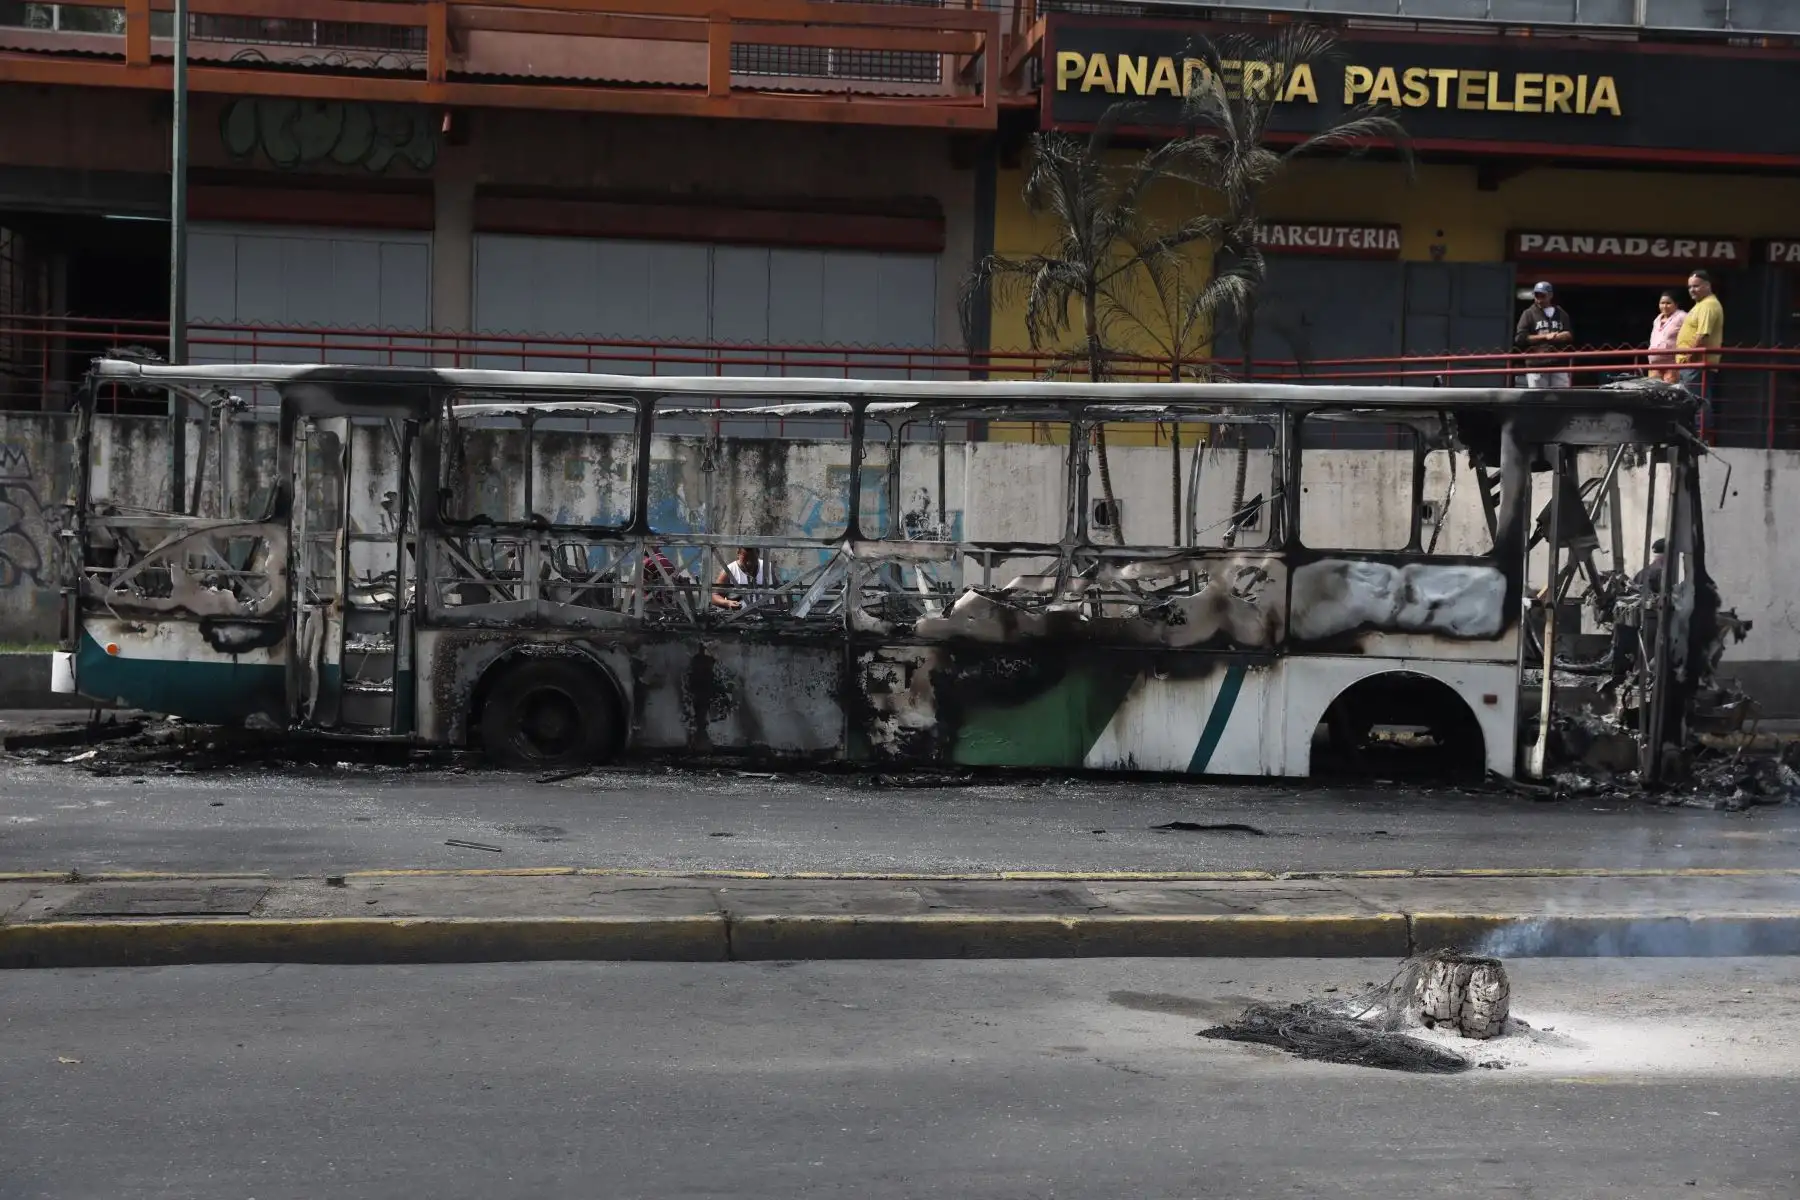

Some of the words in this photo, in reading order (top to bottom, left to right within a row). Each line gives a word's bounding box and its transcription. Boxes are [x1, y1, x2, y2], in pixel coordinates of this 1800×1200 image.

[1056, 51, 1319, 104] PANADERIA
[1343, 65, 1622, 116] PASTELERIA
[1252, 224, 1400, 249] HARCUTERIA
[1520, 234, 1736, 259] PANADERIA
